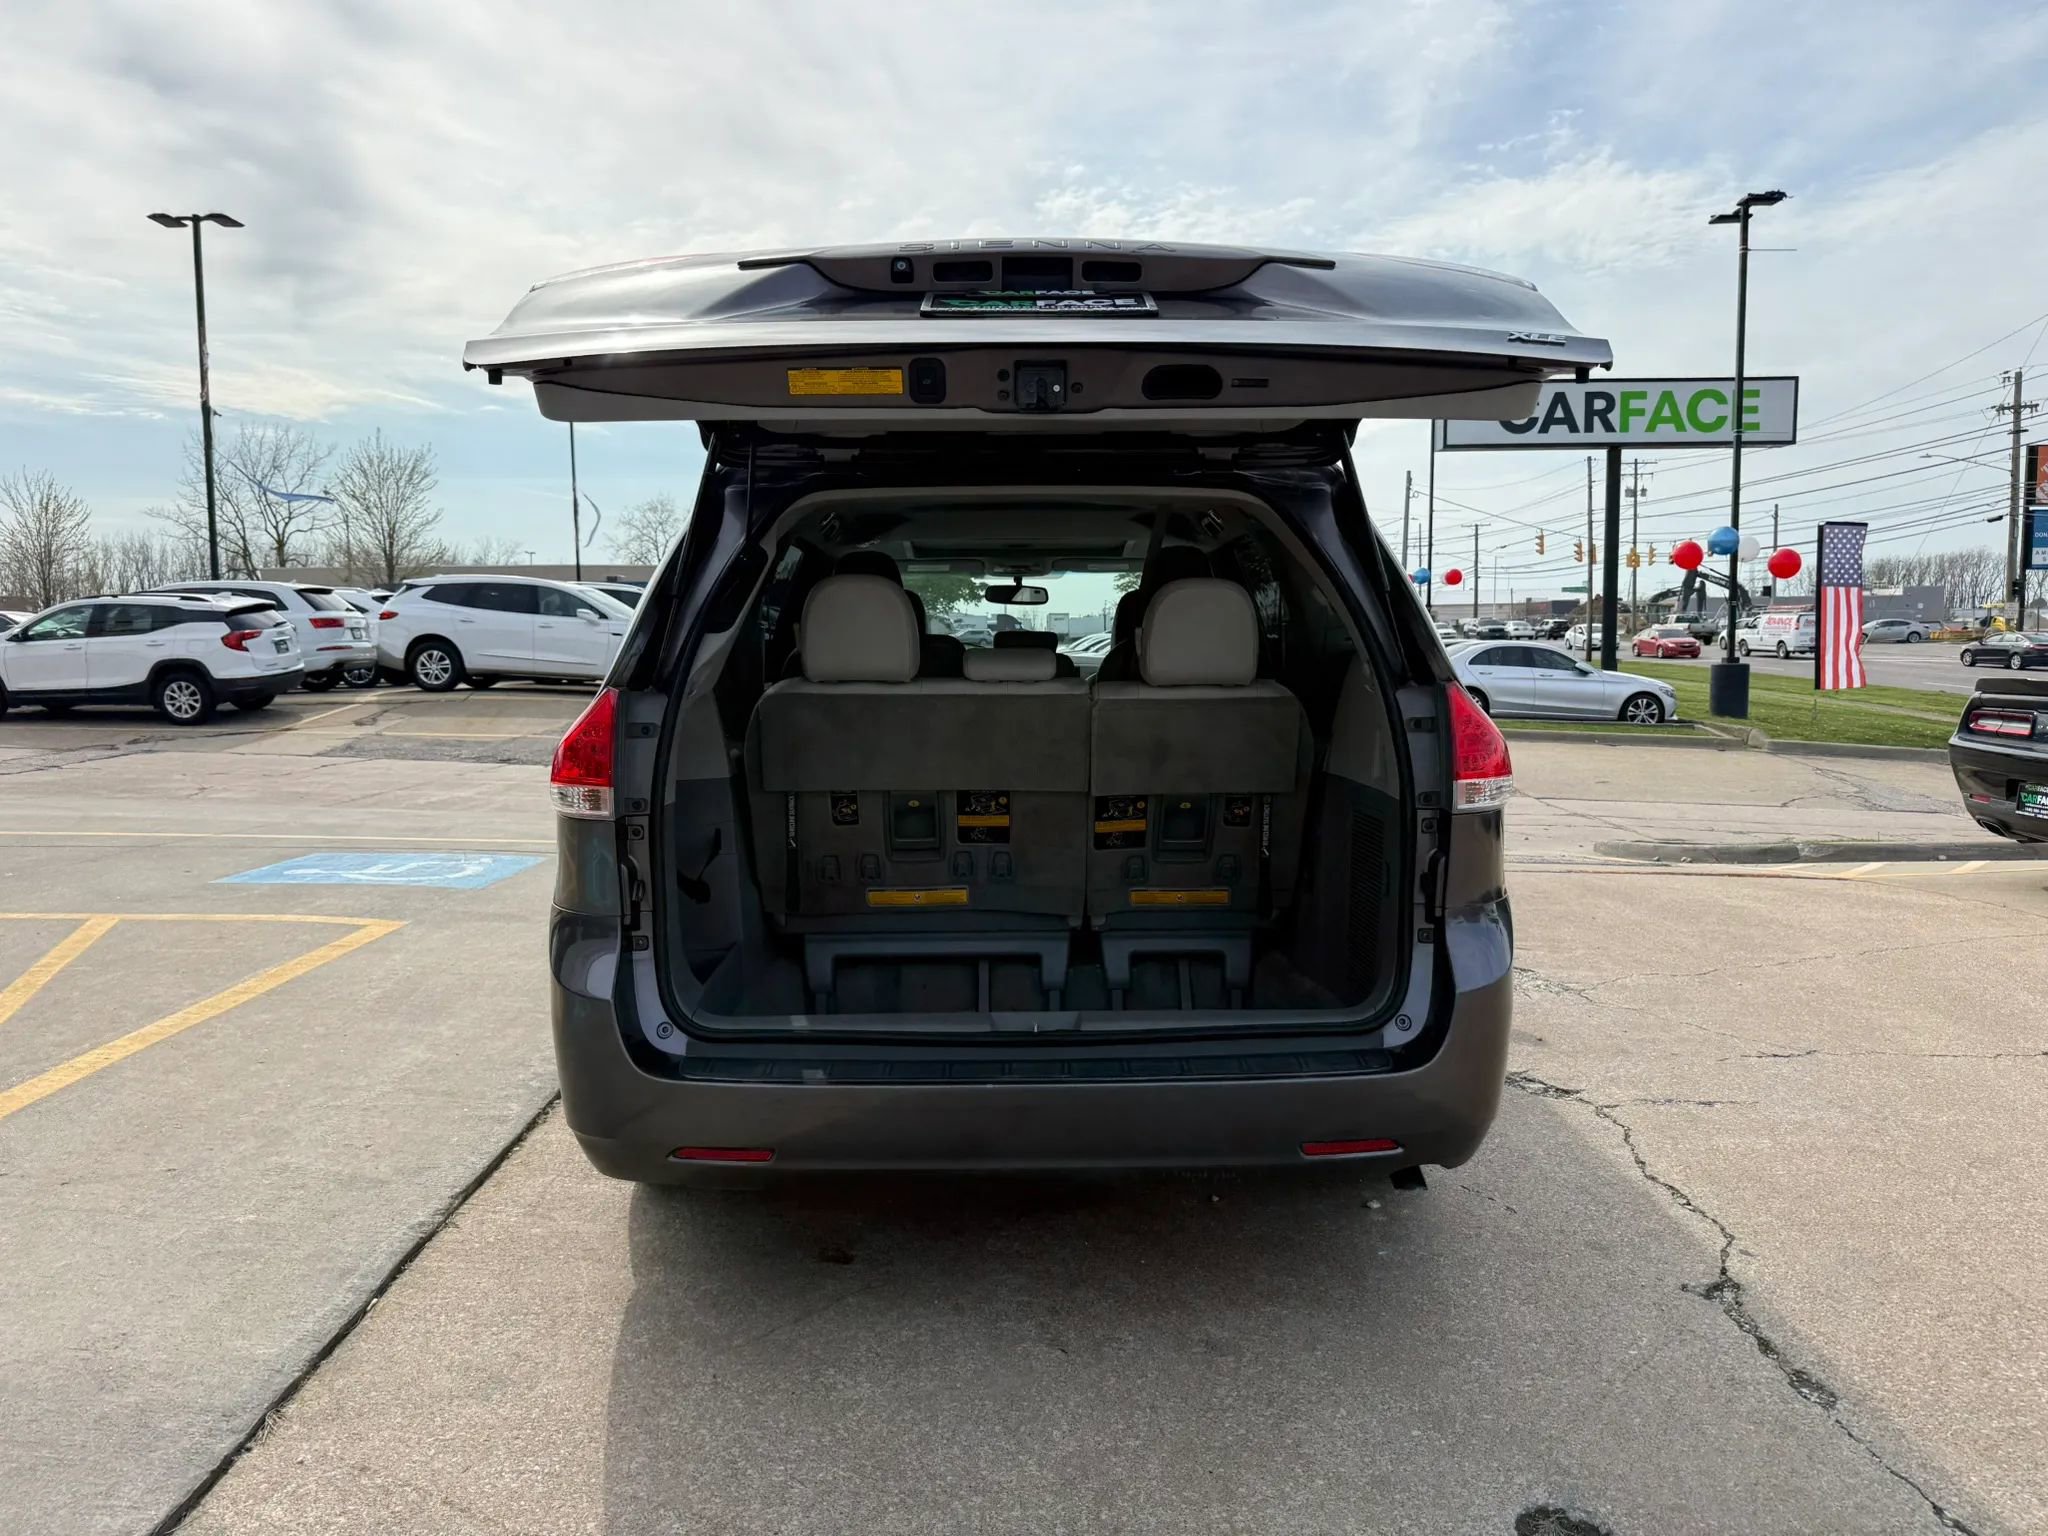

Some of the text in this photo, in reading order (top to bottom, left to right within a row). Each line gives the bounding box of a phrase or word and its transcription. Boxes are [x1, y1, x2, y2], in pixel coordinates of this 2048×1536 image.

[898, 238, 1177, 254] SIENNA
[1507, 330, 1567, 347] XLE
[2020, 792, 2048, 805] CARFA
